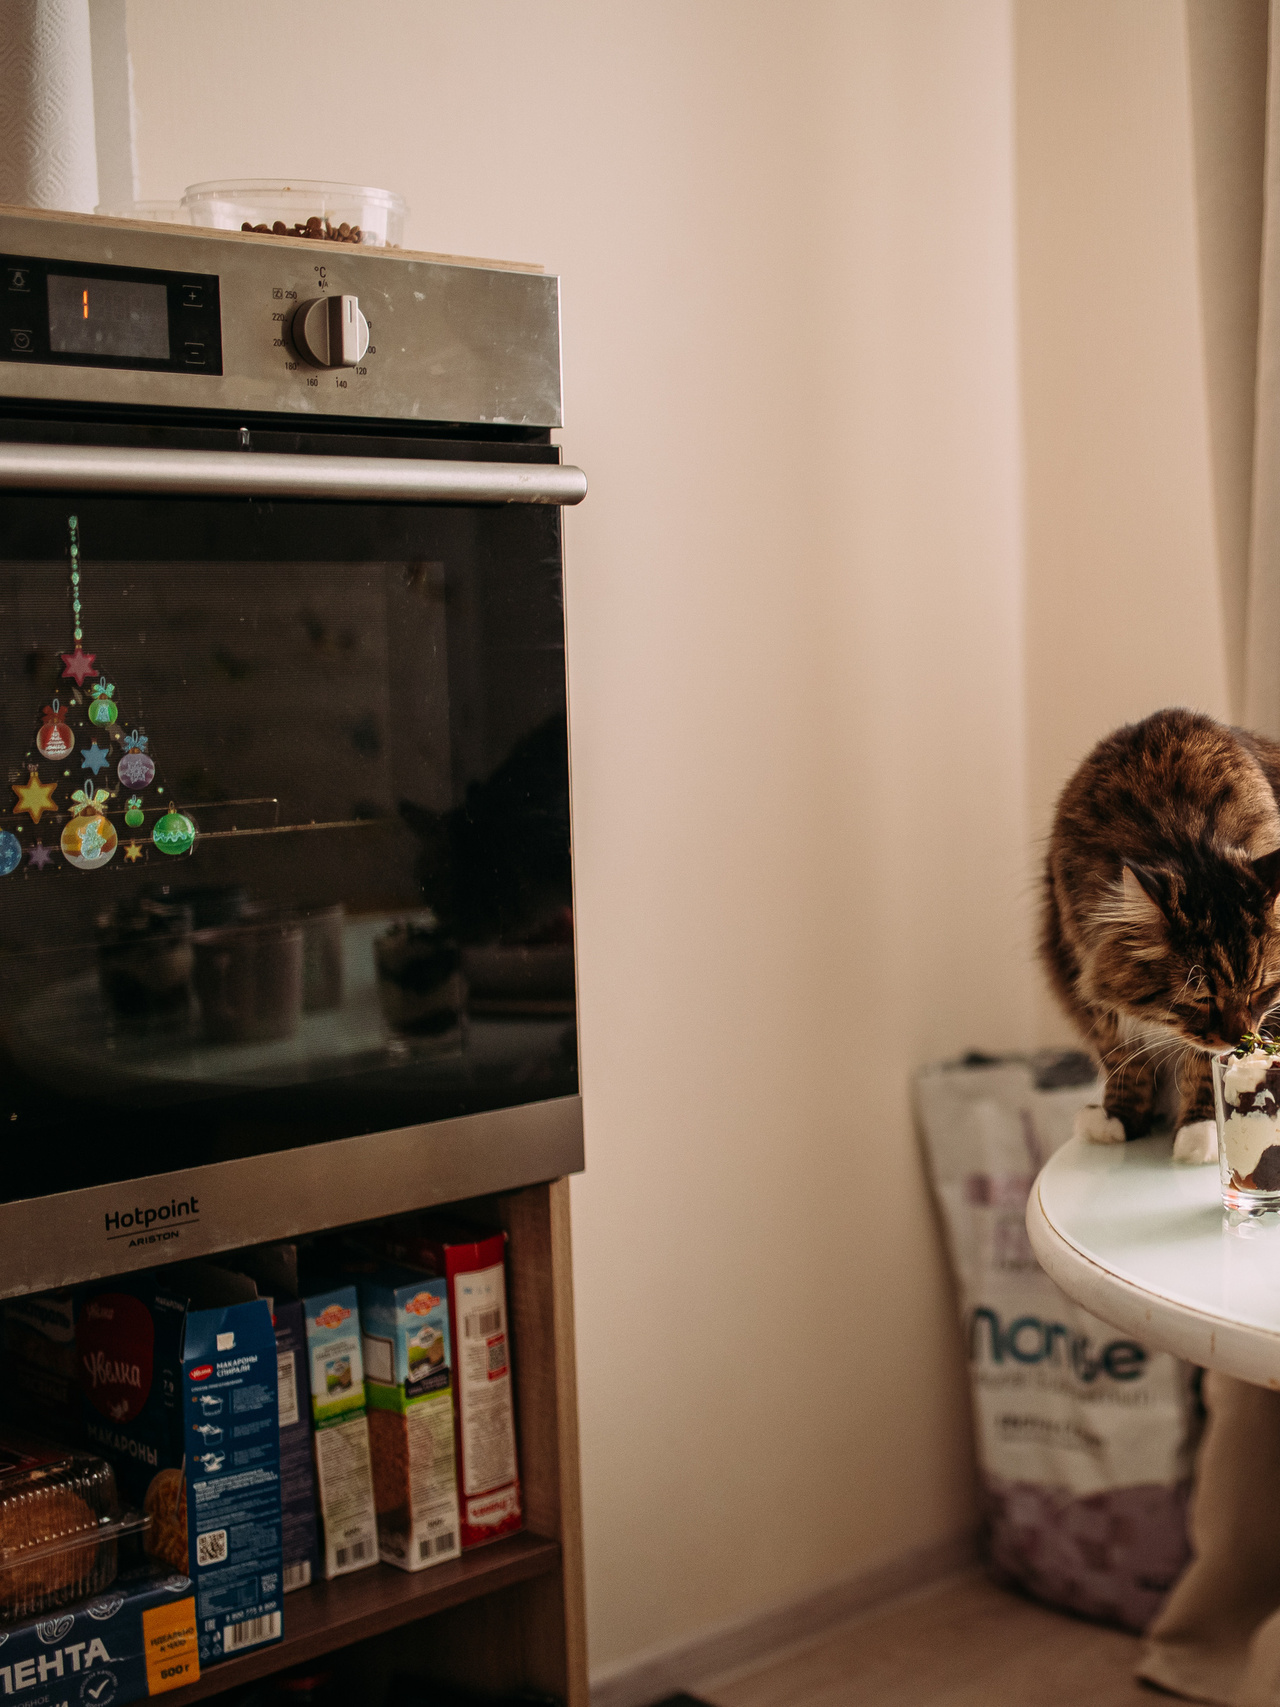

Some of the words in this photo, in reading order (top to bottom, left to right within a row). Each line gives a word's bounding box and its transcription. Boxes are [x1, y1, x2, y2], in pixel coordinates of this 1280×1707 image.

[285, 290, 298, 300] 250
[272, 312, 285, 322] 220
[273, 338, 286, 347] 200
[366, 345, 377, 355] 00
[285, 362, 297, 370] 180
[355, 366, 367, 375] 120
[306, 378, 318, 387] 160
[335, 380, 347, 389] 140
[105, 1196, 199, 1231] Hotpoint
[128, 1230, 179, 1248] ARISTON
[216, 1355, 258, 1370] МАКАРОНЫ
[83, 1350, 142, 1389] Увелка
[87, 1422, 158, 1467] МАКАРОНЫ
[160, 1664, 183, 1680] 500
